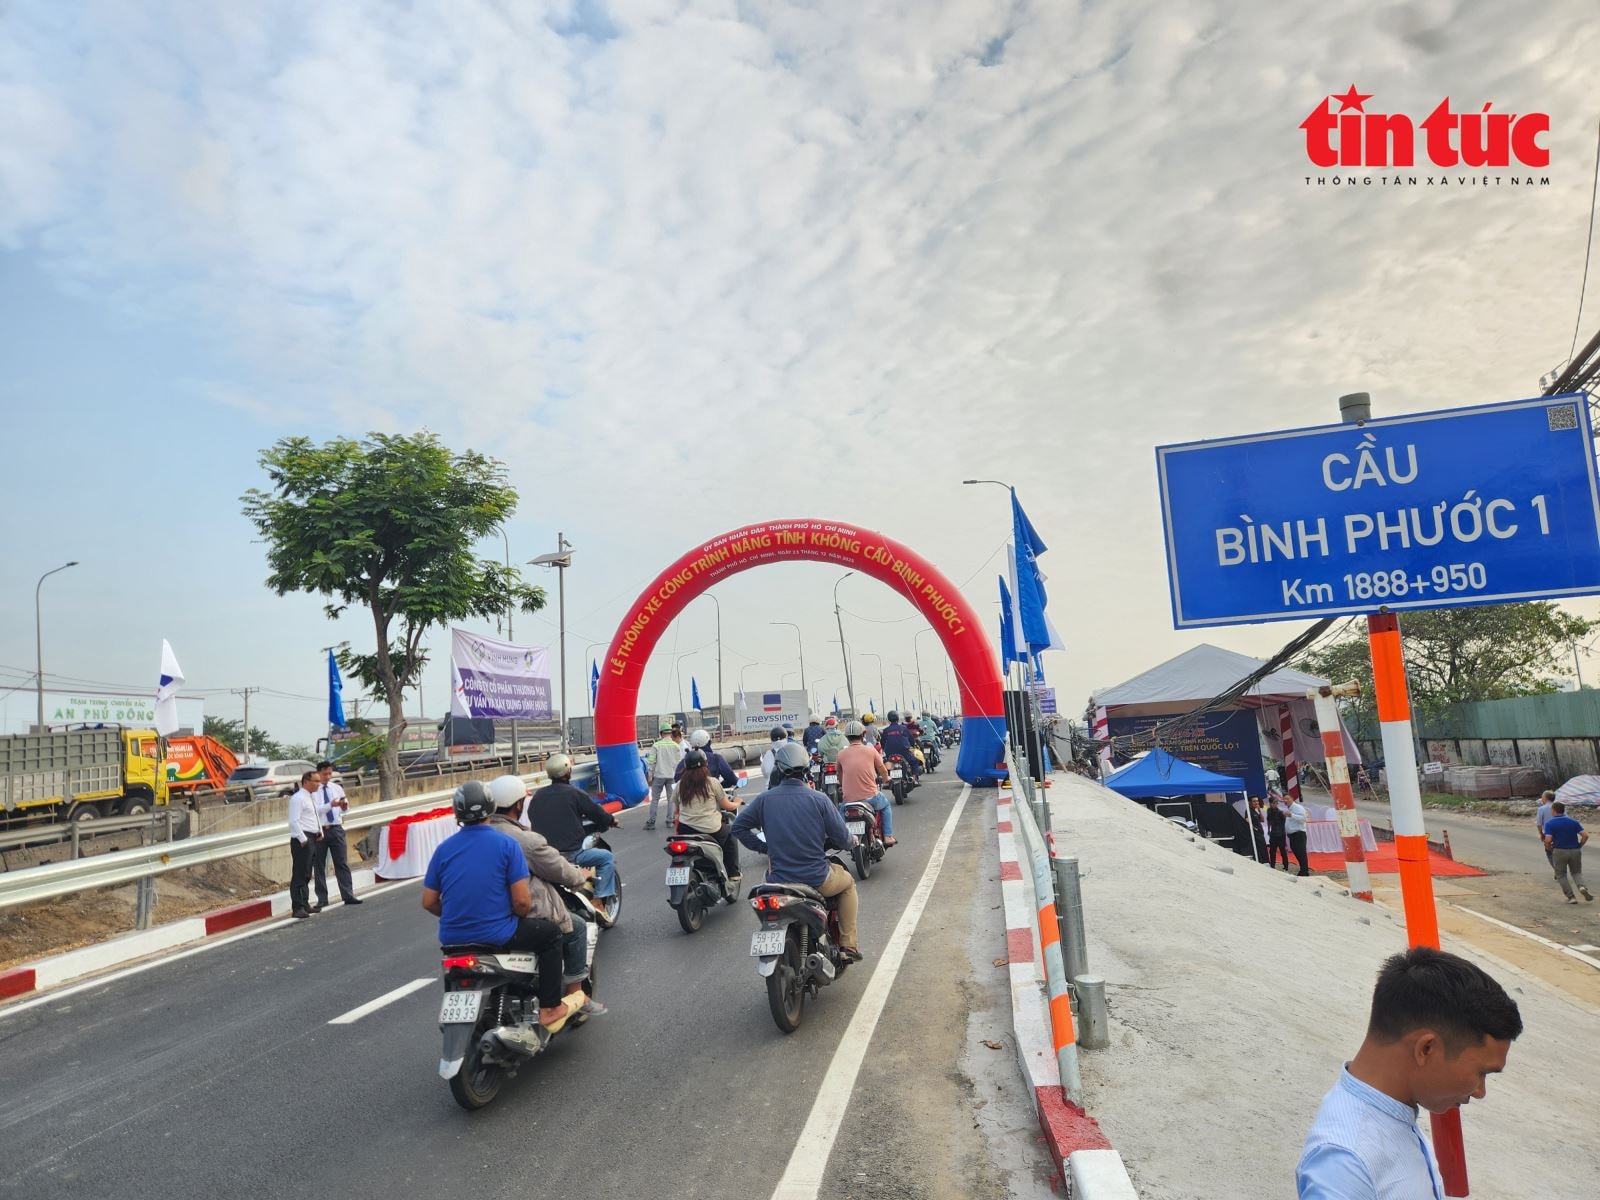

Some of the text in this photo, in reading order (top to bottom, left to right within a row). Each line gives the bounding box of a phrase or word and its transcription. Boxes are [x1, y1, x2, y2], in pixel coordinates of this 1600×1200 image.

[1321, 432, 1419, 492] CẦU
[713, 537, 728, 547] BAN
[769, 523, 793, 531] THÀNH
[837, 528, 857, 537] MINH
[1215, 490, 1550, 567] BÌNH PHƯỚC 1
[1281, 562, 1487, 606] Km 1888+950
[610, 530, 966, 676] LỄ THÔNG XE CÔNG TRÌNH NÂNG TĨNH KHÔNG CẦU BÌNH PHƯỚC 1
[464, 677, 483, 691] CÔNG
[482, 681, 489, 692] TY
[54, 708, 75, 720] AN
[83, 704, 109, 720] PHÚ
[474, 692, 487, 708] VẤN
[448, 993, 476, 1006] 59-V2
